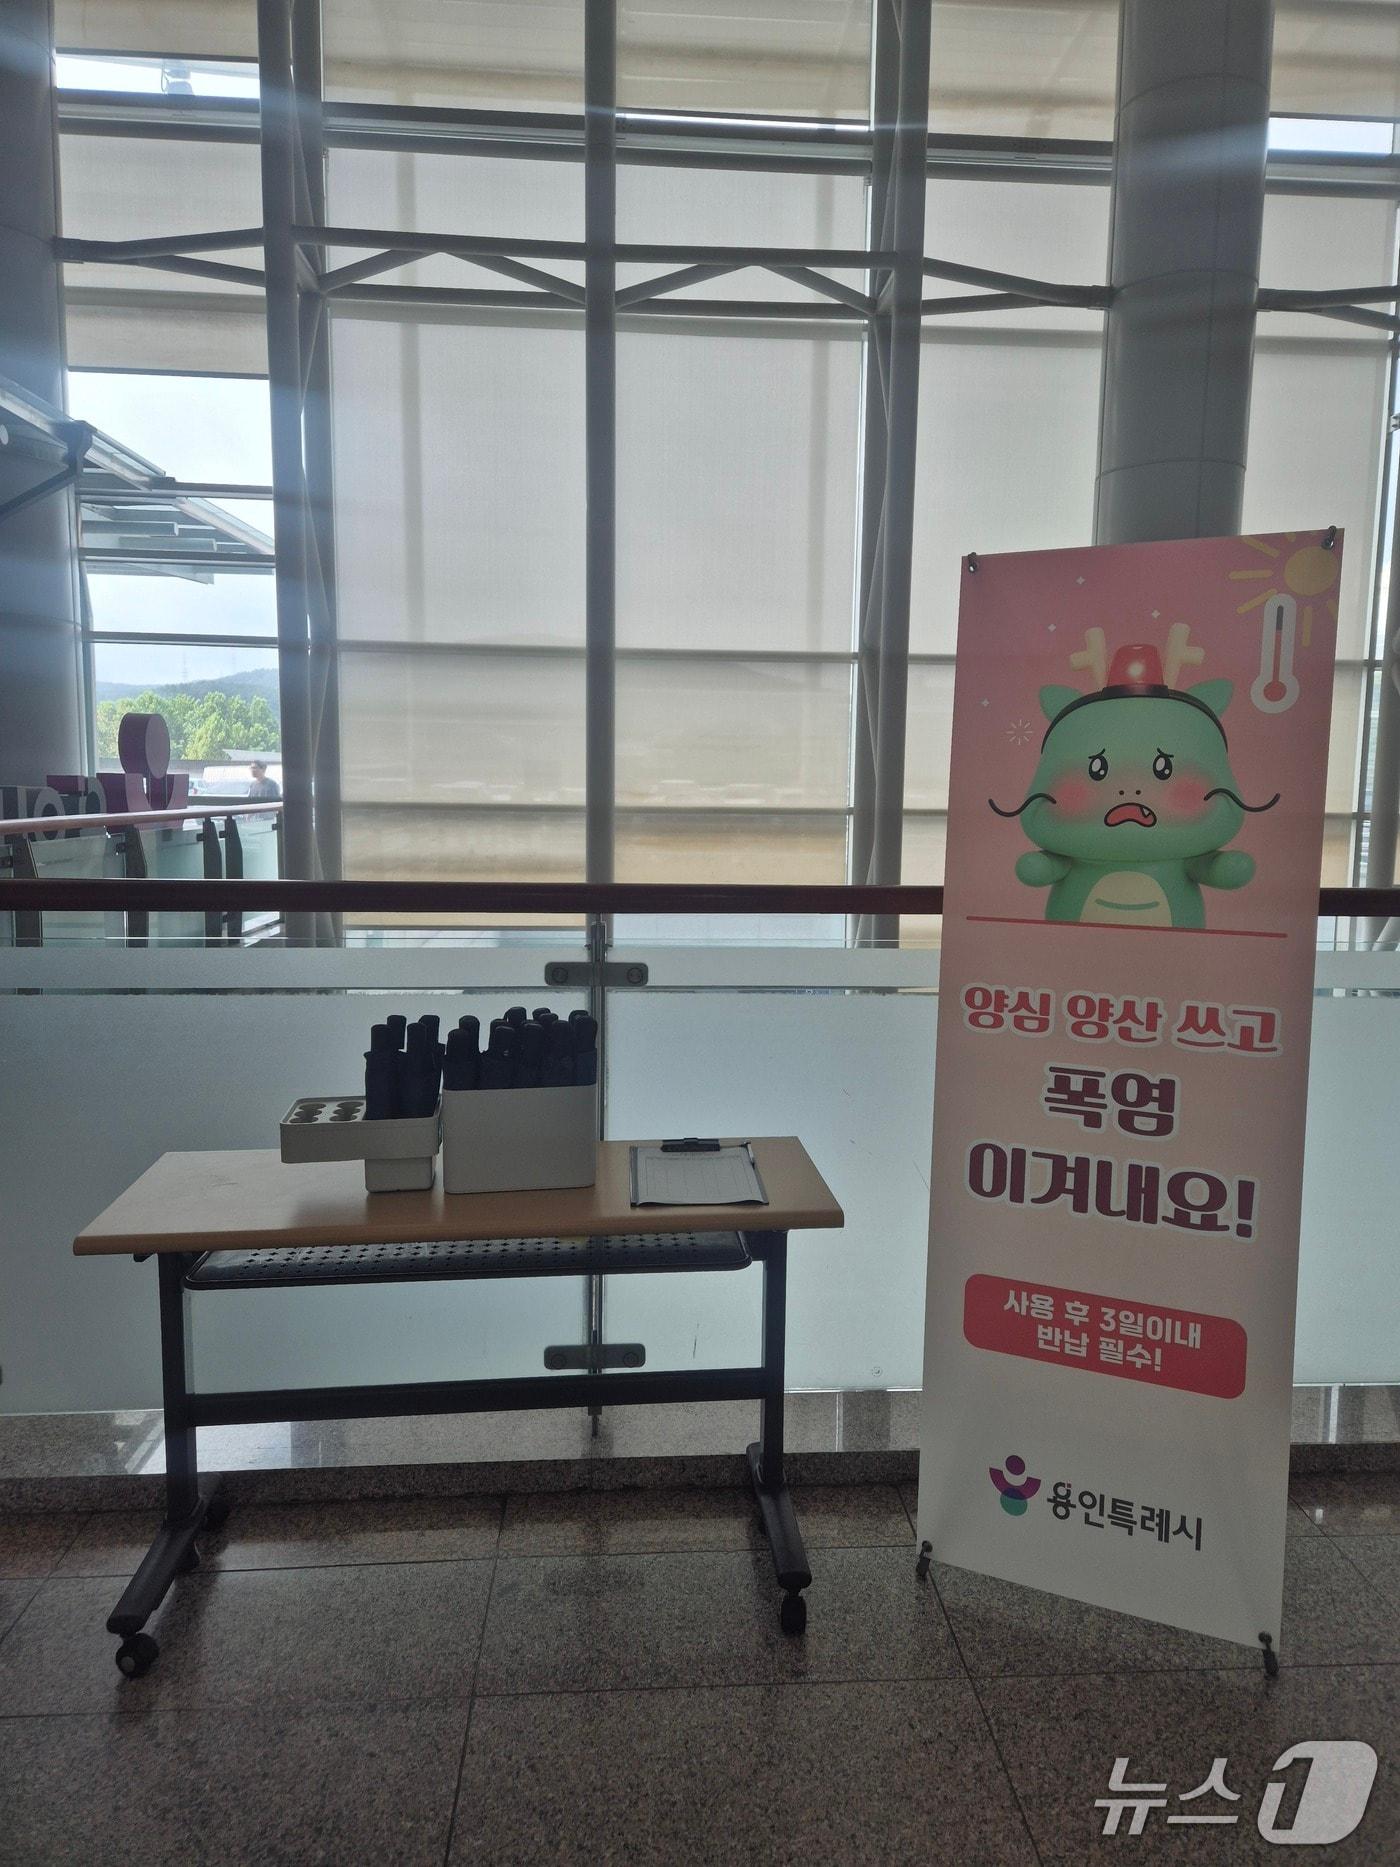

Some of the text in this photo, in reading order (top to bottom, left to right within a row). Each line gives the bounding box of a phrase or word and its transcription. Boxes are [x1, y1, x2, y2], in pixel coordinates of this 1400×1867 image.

[964, 986, 1279, 1052] 양심 양산 쓰고
[1044, 1066, 1176, 1137] 폭염
[968, 1143, 1256, 1239] 이겨내요!
[1003, 1289, 1201, 1349] 사용 후 3일이내
[1037, 1324, 1162, 1372] 반납 필수!
[1047, 1481, 1203, 1551] 용인특례시
